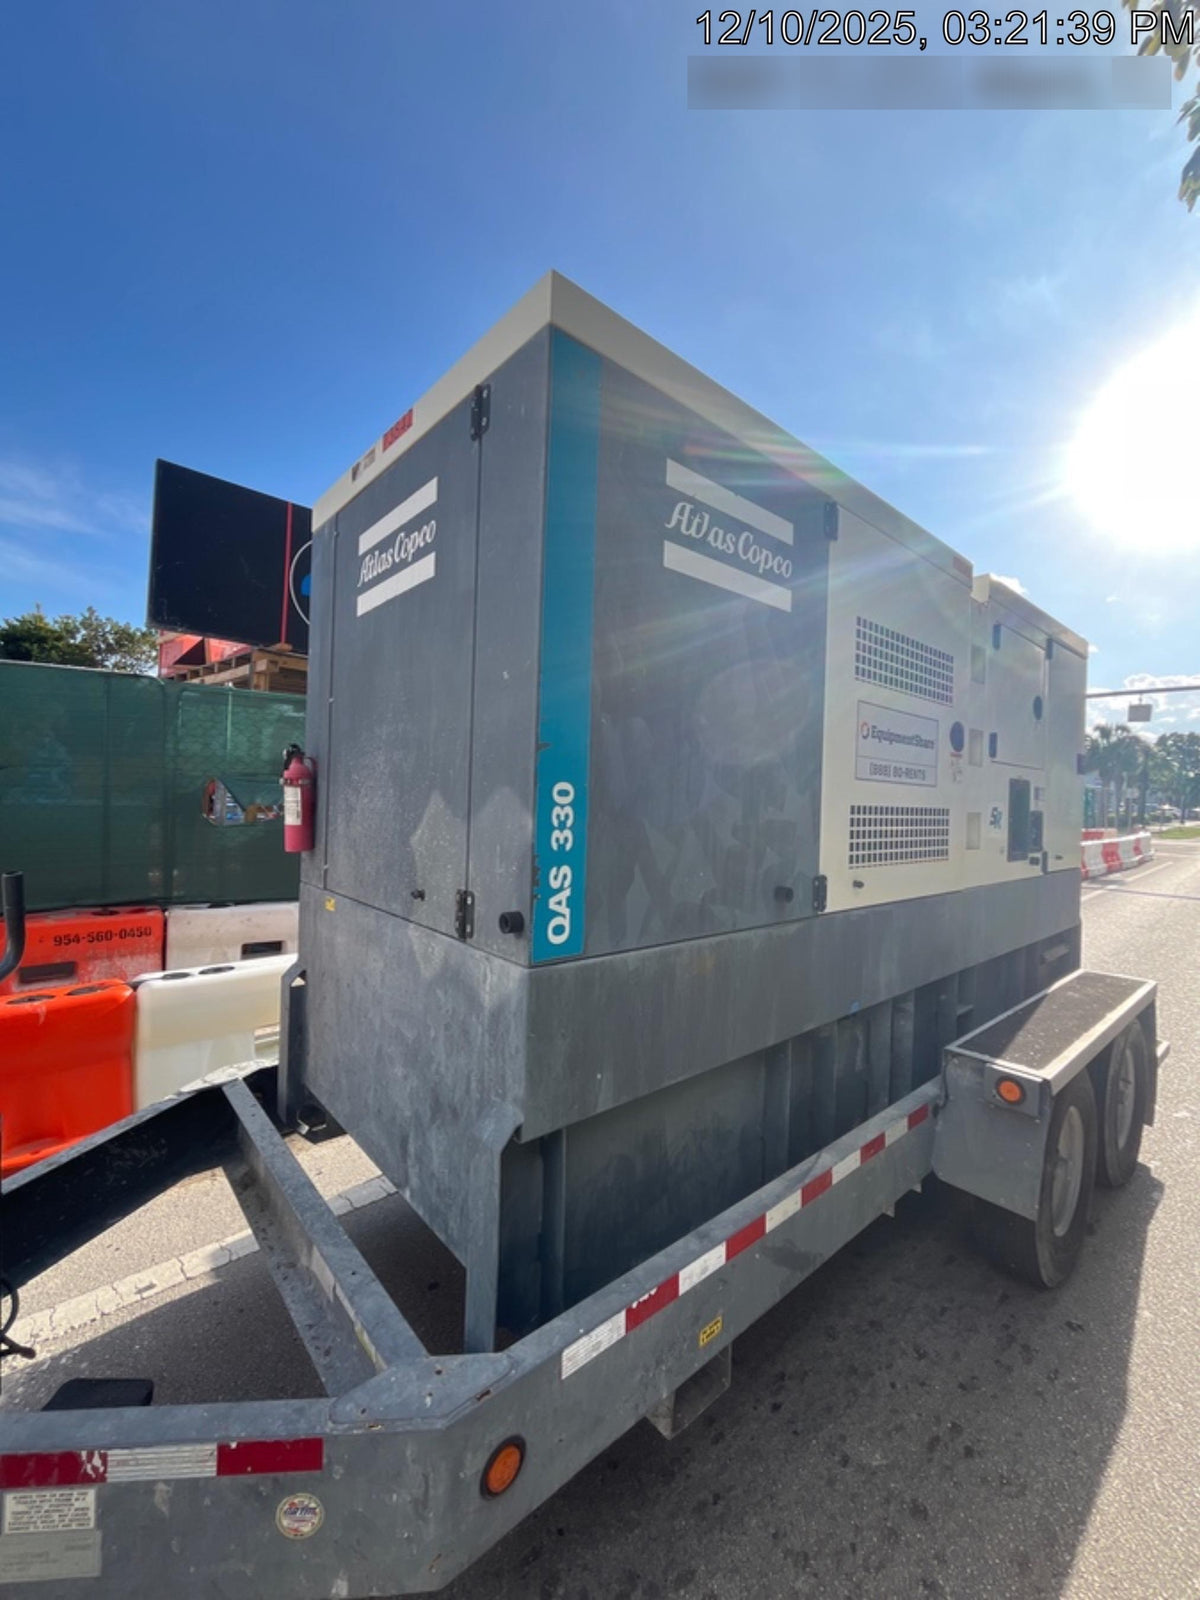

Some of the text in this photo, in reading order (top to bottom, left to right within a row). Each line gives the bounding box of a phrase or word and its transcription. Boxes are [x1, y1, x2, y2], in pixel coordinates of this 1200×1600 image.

[546, 781, 576, 945] QAS 330
[53, 925, 152, 947] 954-560-0450
